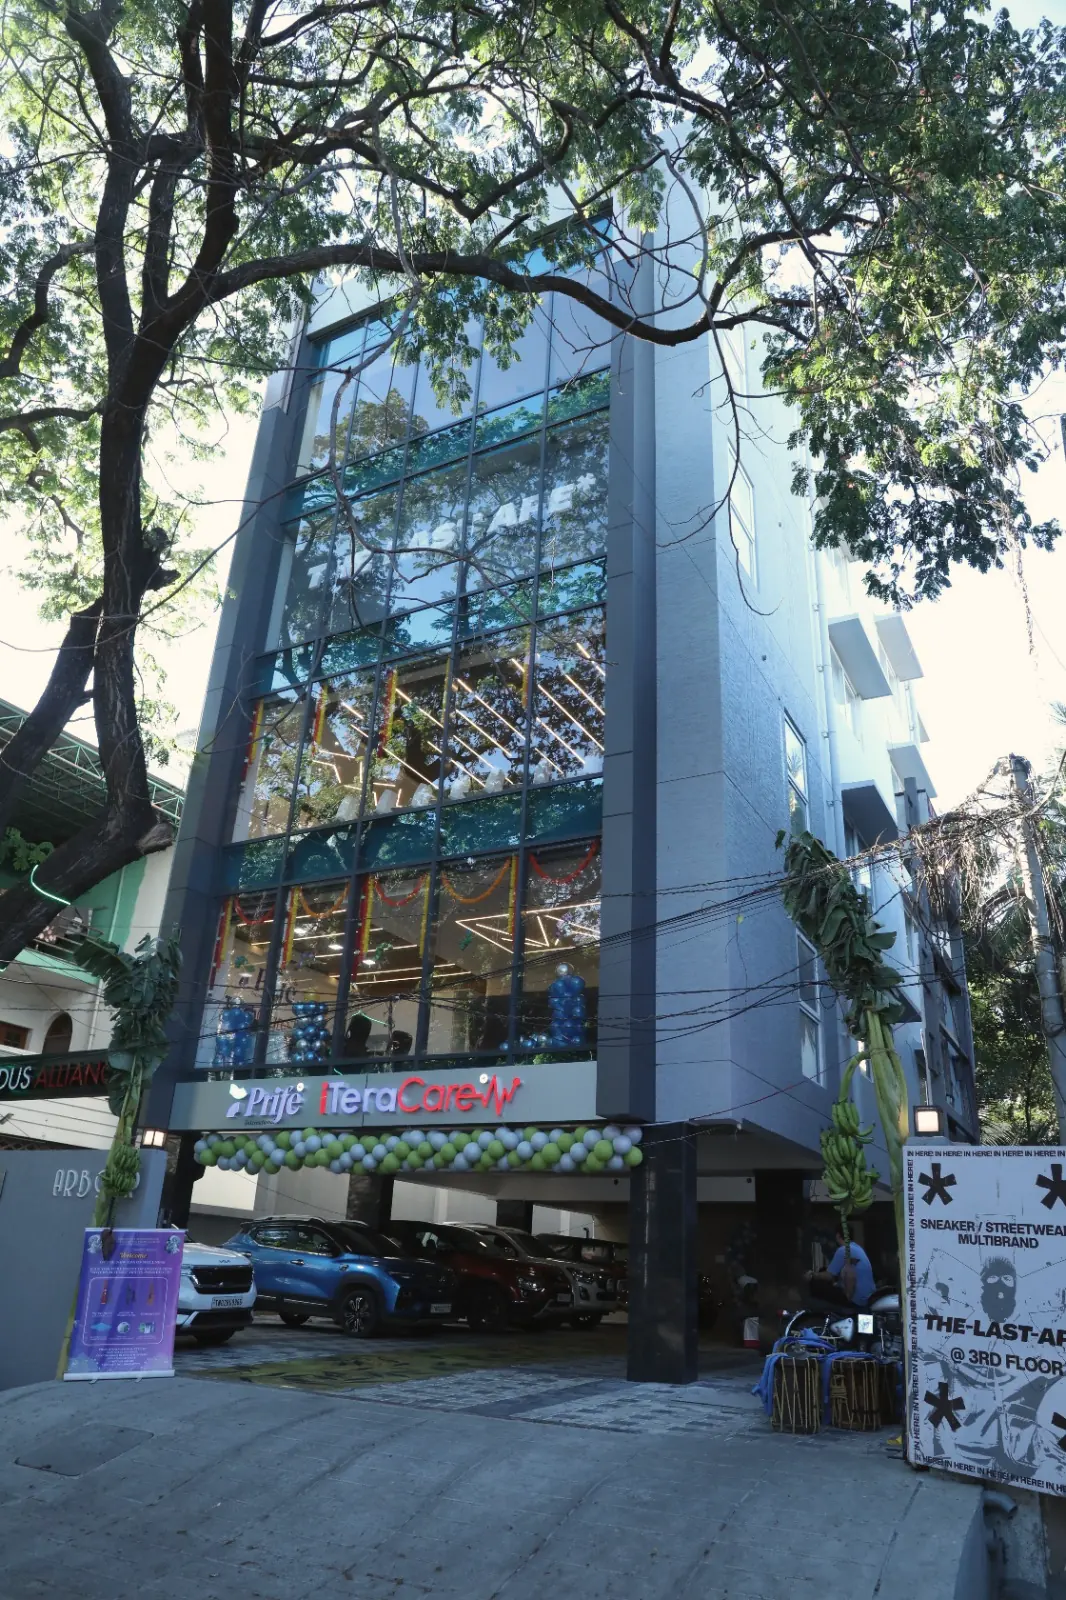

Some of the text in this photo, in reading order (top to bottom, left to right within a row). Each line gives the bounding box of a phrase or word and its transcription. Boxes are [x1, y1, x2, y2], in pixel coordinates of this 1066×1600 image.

[243, 1076, 482, 1124] Prife iTeraCare
[920, 1218, 976, 1232] SNEAKER
[957, 1233, 1040, 1249] MULTIBRAND
[950, 1347, 1064, 1376] @ 3RD FLOOR
